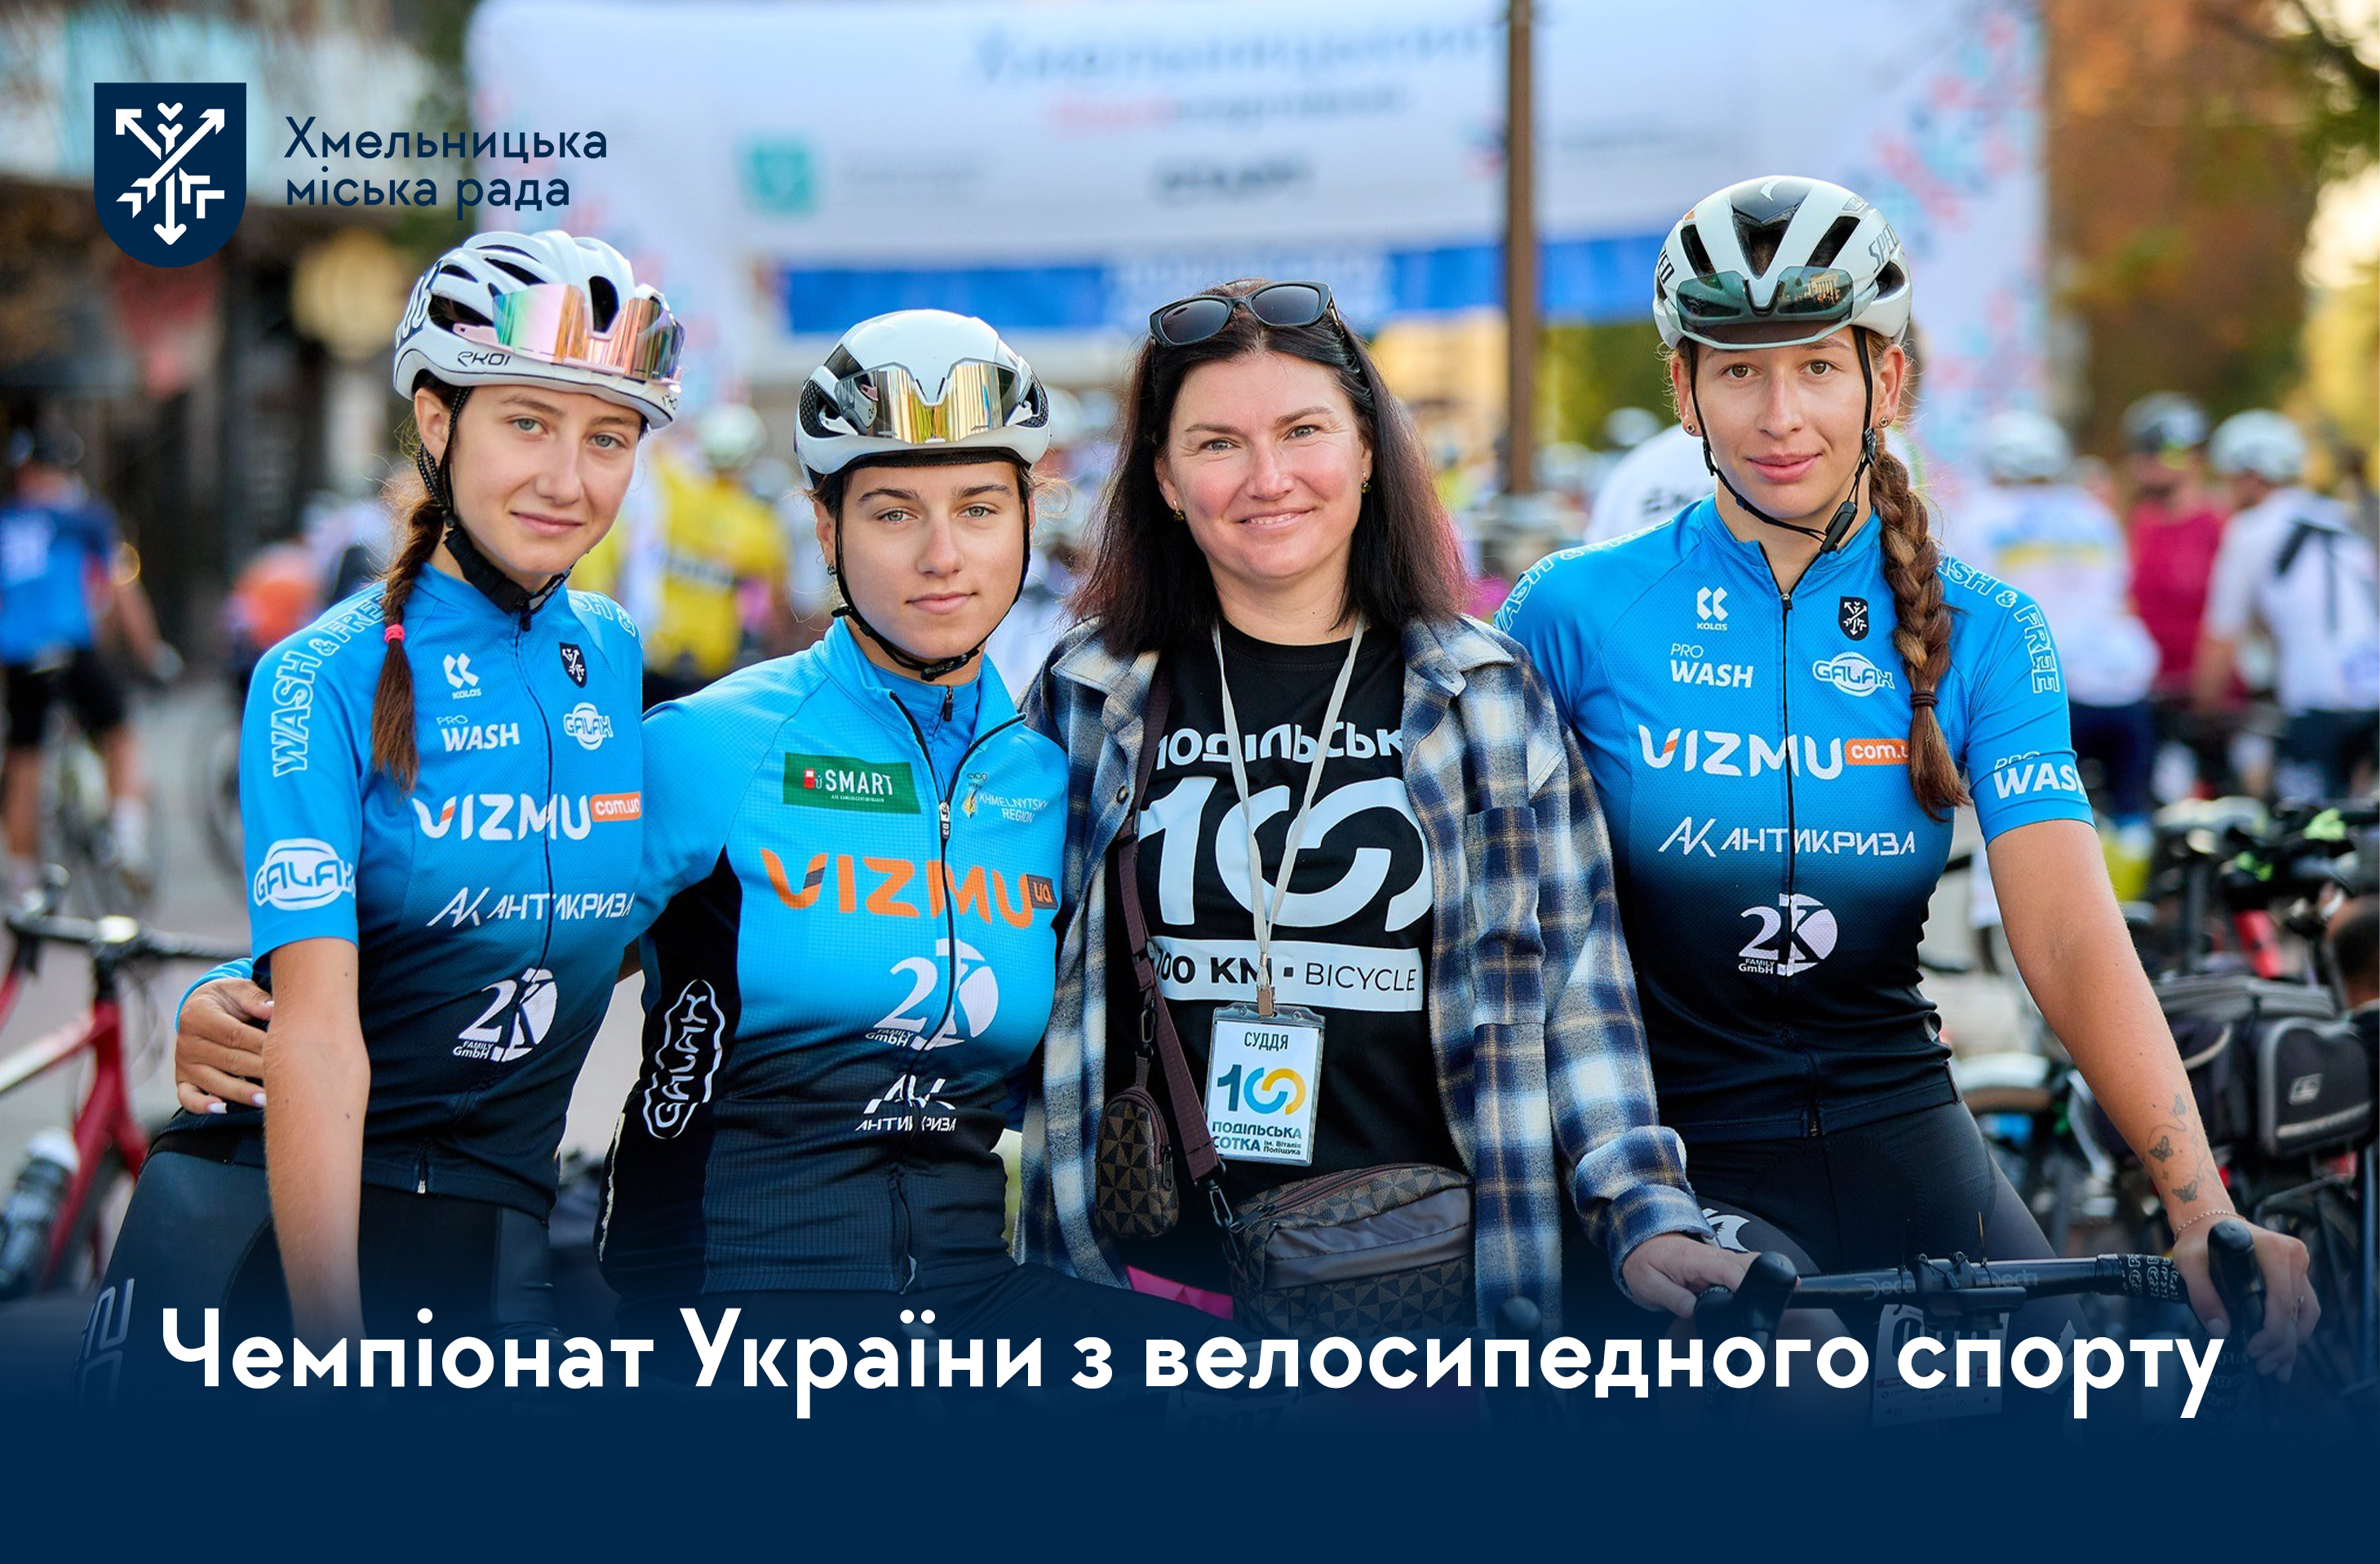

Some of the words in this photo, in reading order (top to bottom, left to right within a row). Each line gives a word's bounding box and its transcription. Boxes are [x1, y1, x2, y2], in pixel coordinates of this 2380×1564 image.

[1670, 642, 1704, 659] PRO
[1996, 590, 2018, 608] &
[2014, 604, 2061, 694] FREE
[1670, 659, 1754, 689] WASH
[271, 650, 322, 778] WASH
[308, 637, 340, 657] &
[436, 714, 468, 726] PRO
[441, 722, 521, 751] WASH
[1638, 724, 1843, 780] VIZMU
[824, 769, 894, 795] SMART
[412, 793, 592, 841] VIZMU
[1000, 807, 1035, 824] REGION
[1720, 827, 1917, 857] АНТИКРИЗА
[760, 848, 1035, 930] VIZMU
[1032, 881, 1054, 903] ua
[486, 892, 636, 920] АНТИКРИЗА
[1738, 963, 1774, 975] GmbH
[1745, 958, 1775, 967] FAMILY
[1305, 962, 1417, 992] BICYCLE
[865, 1031, 911, 1048] GmbH
[1244, 1031, 1289, 1052] СУДДЯ
[452, 1046, 490, 1060] GmbH
[855, 1115, 957, 1132] АНТИРИЗА
[1212, 1121, 1302, 1139] ПОДІЛЬСЬКА
[1212, 1136, 1261, 1152] СОТКА
